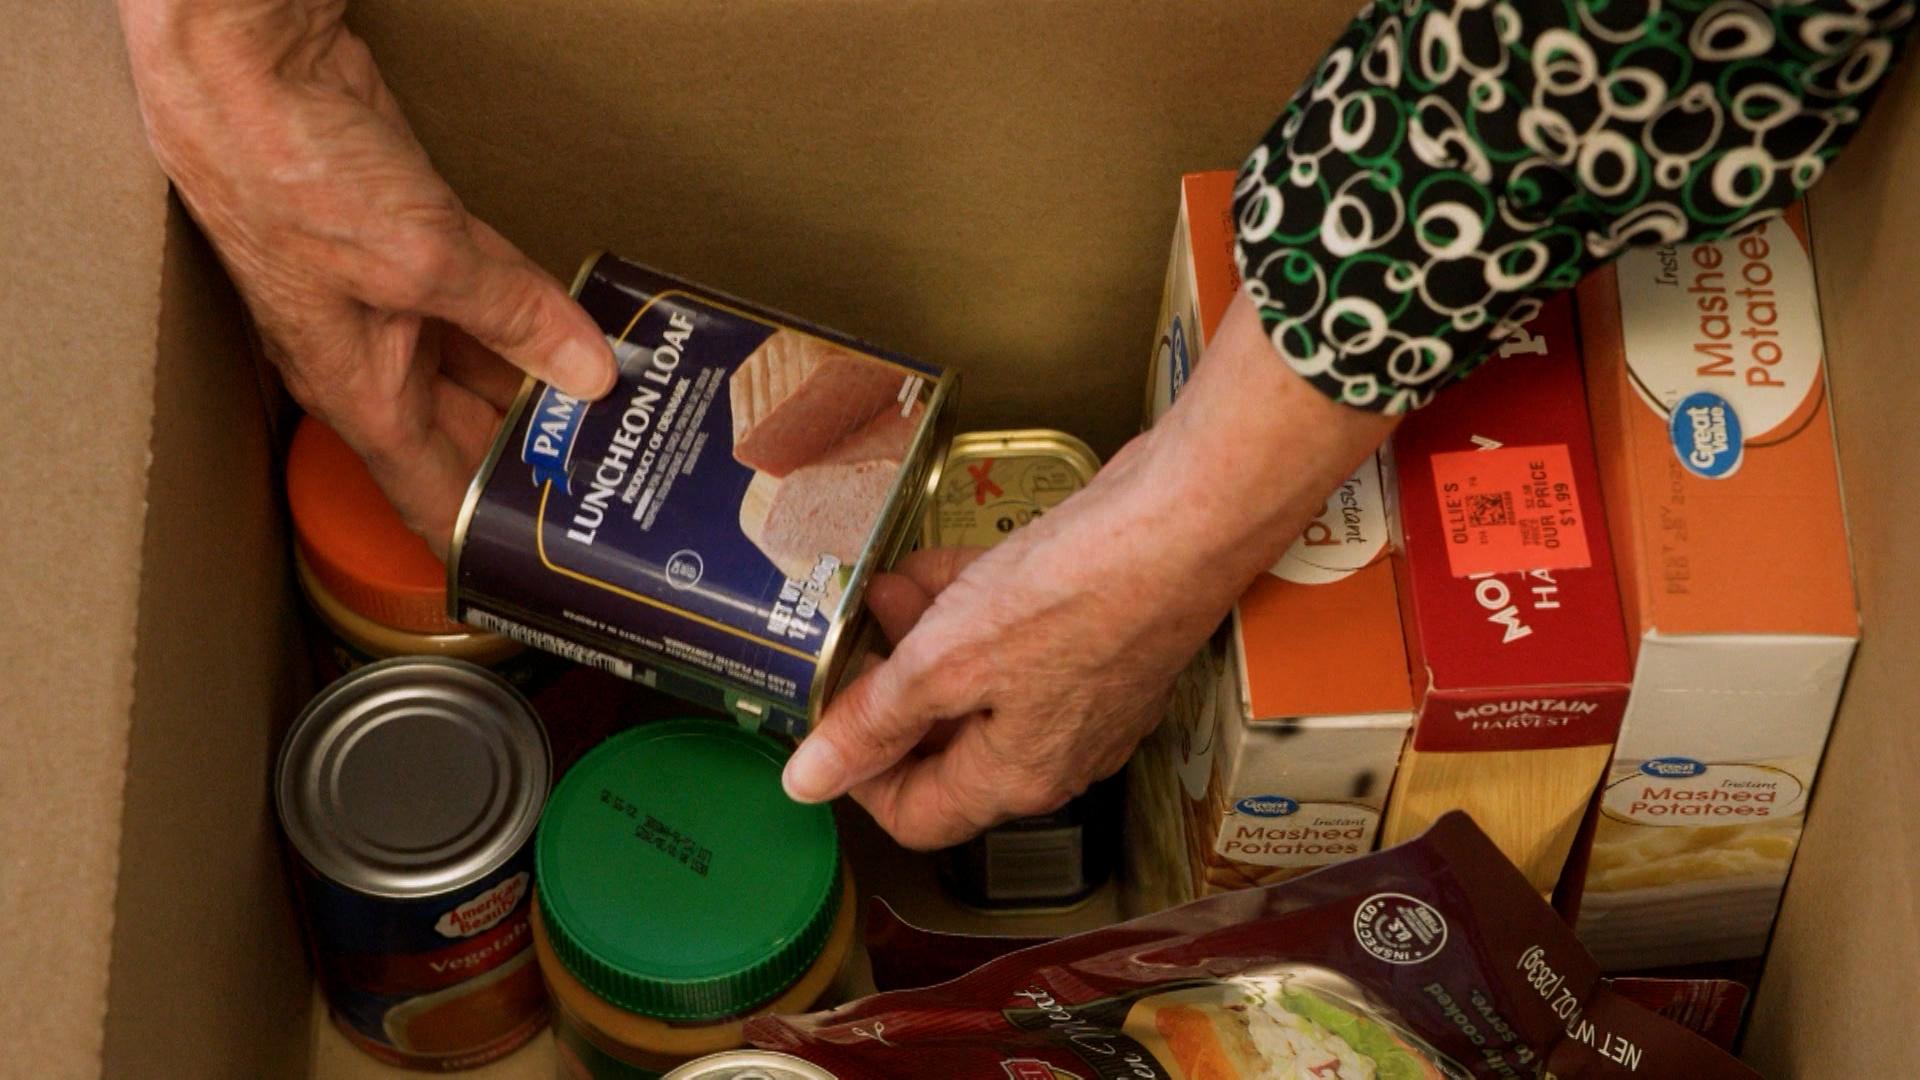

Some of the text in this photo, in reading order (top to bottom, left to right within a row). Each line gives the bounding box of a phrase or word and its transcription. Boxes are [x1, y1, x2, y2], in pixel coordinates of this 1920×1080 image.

[1655, 243, 1679, 287] Inst
[1687, 243, 1736, 378] Mashe
[533, 391, 579, 458] PAM
[566, 385, 662, 546] LUNCHEON
[644, 311, 695, 386] LOAF
[1686, 406, 1716, 469] Great
[1711, 405, 1729, 453] Value
[621, 450, 656, 504] PRODUCT
[649, 431, 665, 450] OF
[1529, 460, 1553, 509] PRICE
[1443, 482, 1469, 545] OLLIE'S
[1553, 483, 1577, 527] $1.99
[1539, 514, 1561, 549] OUR
[1454, 699, 1599, 721] MOUNTAIN
[1472, 716, 1570, 731] HARVEST
[1641, 787, 1777, 803] Mashed
[1721, 778, 1778, 790] Instant
[1313, 817, 1366, 827] Instant
[1630, 801, 1771, 817] Potatoes
[1224, 840, 1359, 855] Potatoes
[1236, 826, 1365, 841] Mashed
[450, 876, 522, 927] American
[459, 896, 517, 935] Beauty
[429, 922, 528, 973] Vegetab
[1359, 904, 1410, 961] INSPECTED
[1516, 945, 1566, 1001] (283g)
[1423, 982, 1487, 1046] cooked
[1551, 987, 1578, 1020] OZ
[1598, 1032, 1643, 1072] NET
